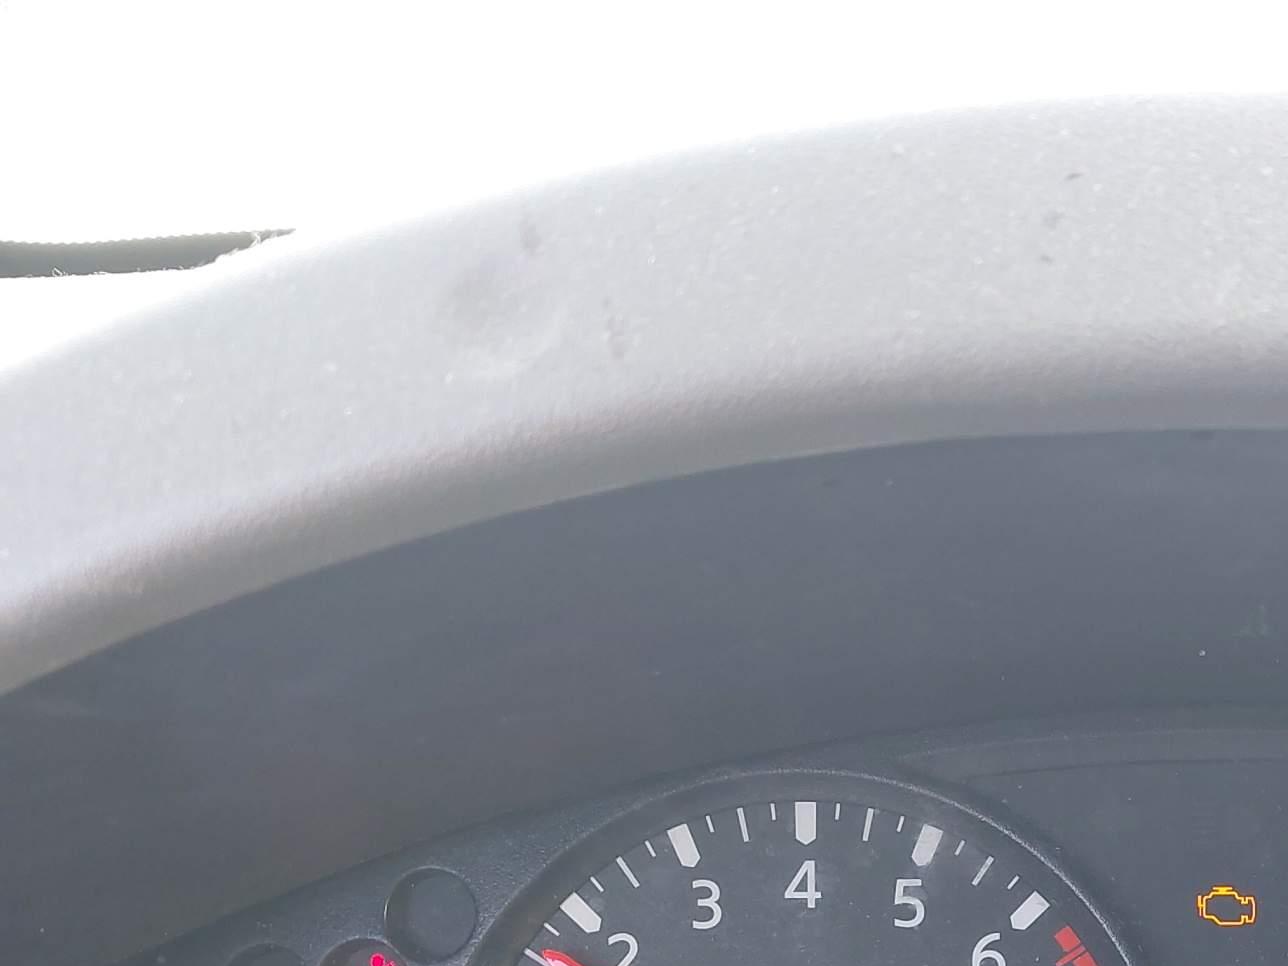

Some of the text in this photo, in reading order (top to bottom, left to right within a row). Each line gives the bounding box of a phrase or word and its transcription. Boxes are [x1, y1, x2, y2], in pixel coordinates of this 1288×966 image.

[692, 880, 722, 930] 3
[784, 860, 821, 908] 4
[894, 879, 924, 928] 5
